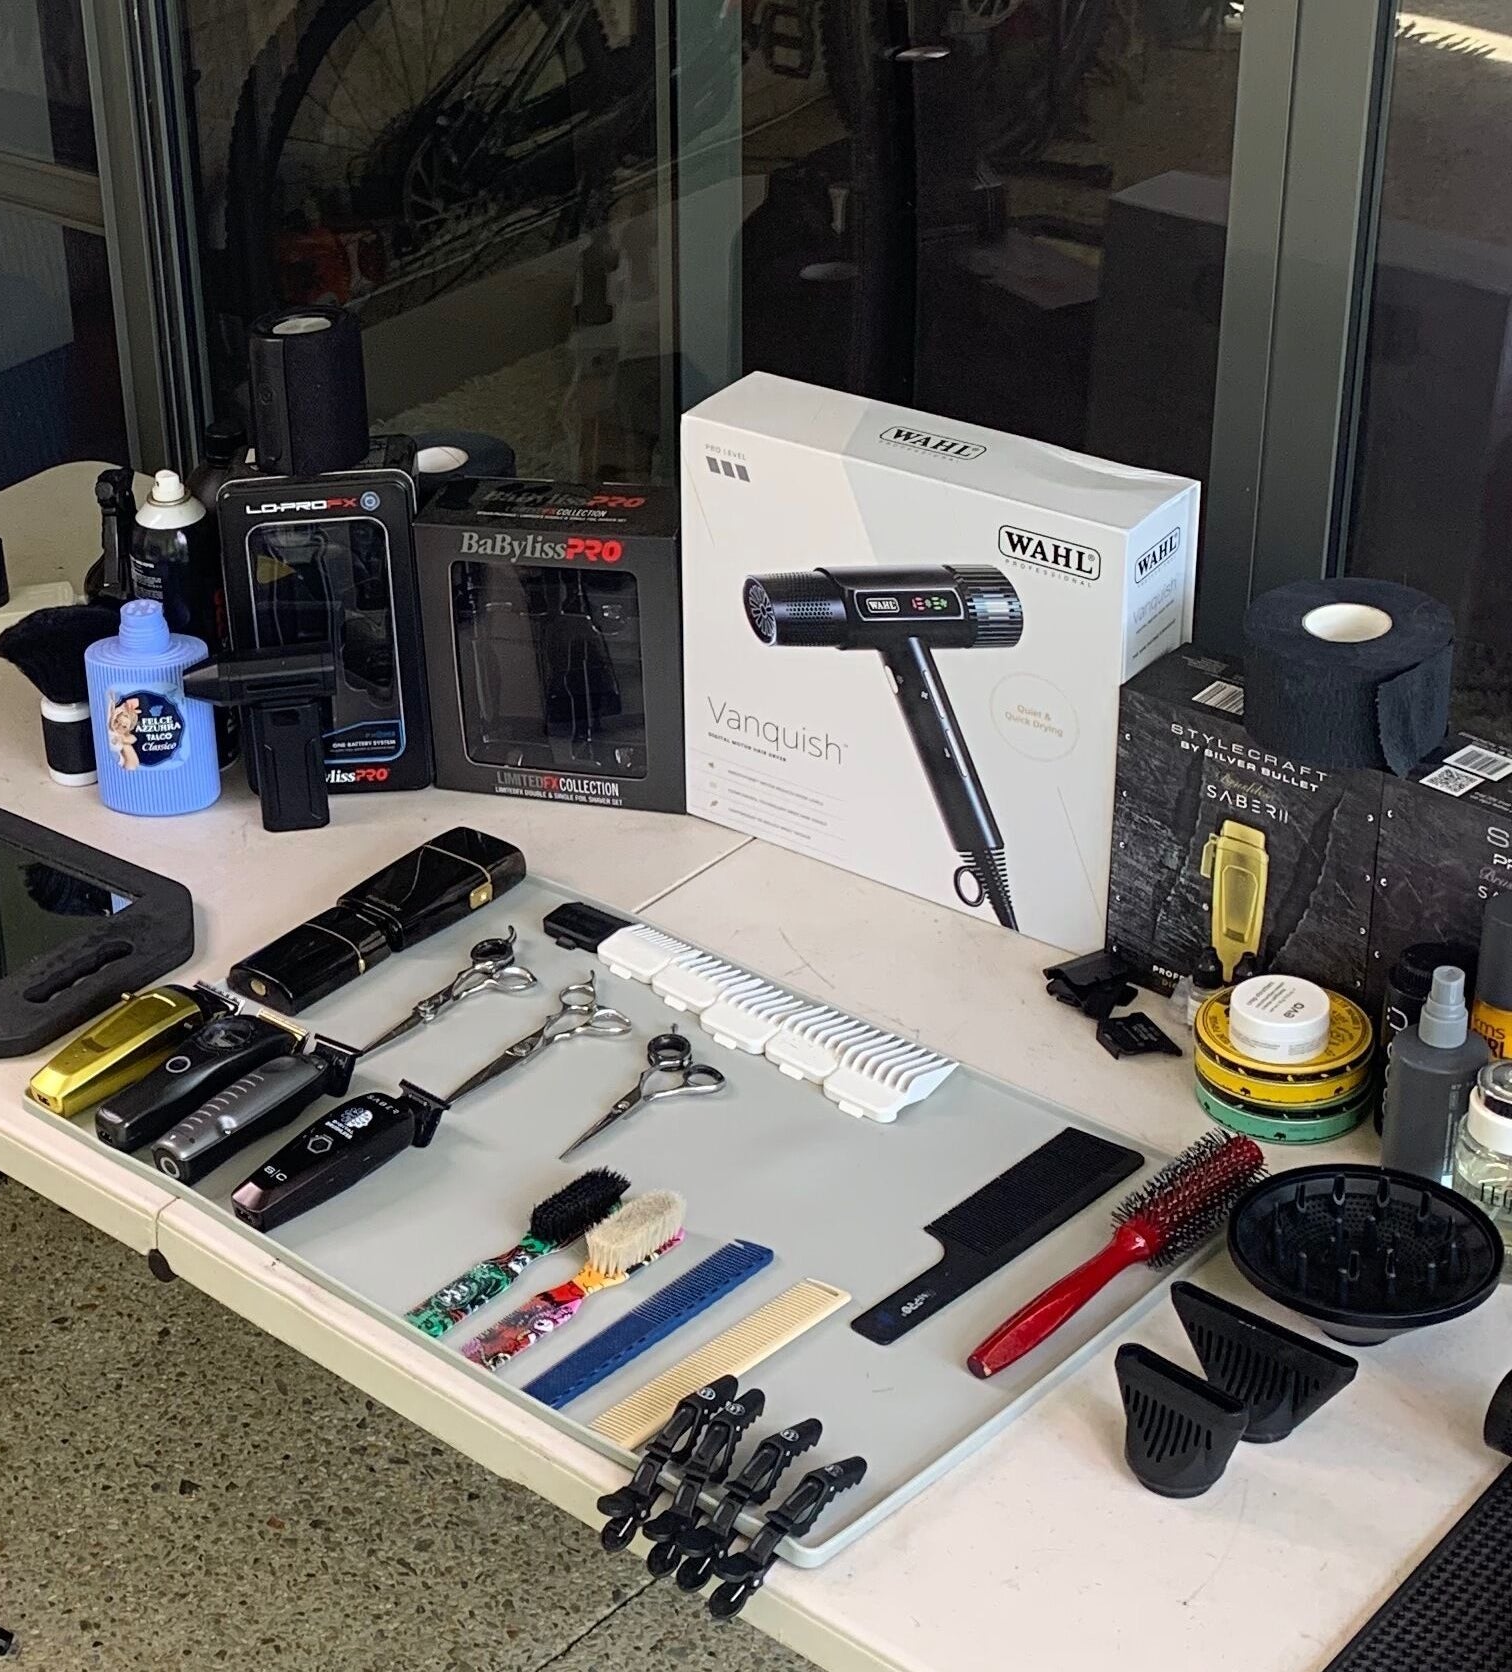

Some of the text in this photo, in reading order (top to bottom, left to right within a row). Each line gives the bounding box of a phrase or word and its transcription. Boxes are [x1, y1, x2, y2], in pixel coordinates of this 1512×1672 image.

[705, 443, 721, 454] PRO
[892, 428, 971, 458] WAHL
[460, 531, 624, 563] BaBylissPRO
[1004, 530, 1094, 575] WAHL
[1137, 534, 1178, 577] WAHL
[1004, 557, 1092, 588] PROFESSIONAL
[868, 600, 897, 611] WAHL
[141, 715, 173, 726] FELCE
[1016, 704, 1042, 719] Quiet
[145, 731, 173, 741] TALCO
[706, 695, 842, 765] Vanquish
[1032, 719, 1064, 738] Drying
[141, 741, 178, 752] Classico
[331, 739, 397, 749] ONE BATTERY SYSTEM
[1170, 722, 1329, 783] STYLECRAFT
[1180, 740, 1320, 793] BY SILVER BULLET
[558, 777, 620, 797] COLLECTION
[1283, 1001, 1305, 1019] evo
